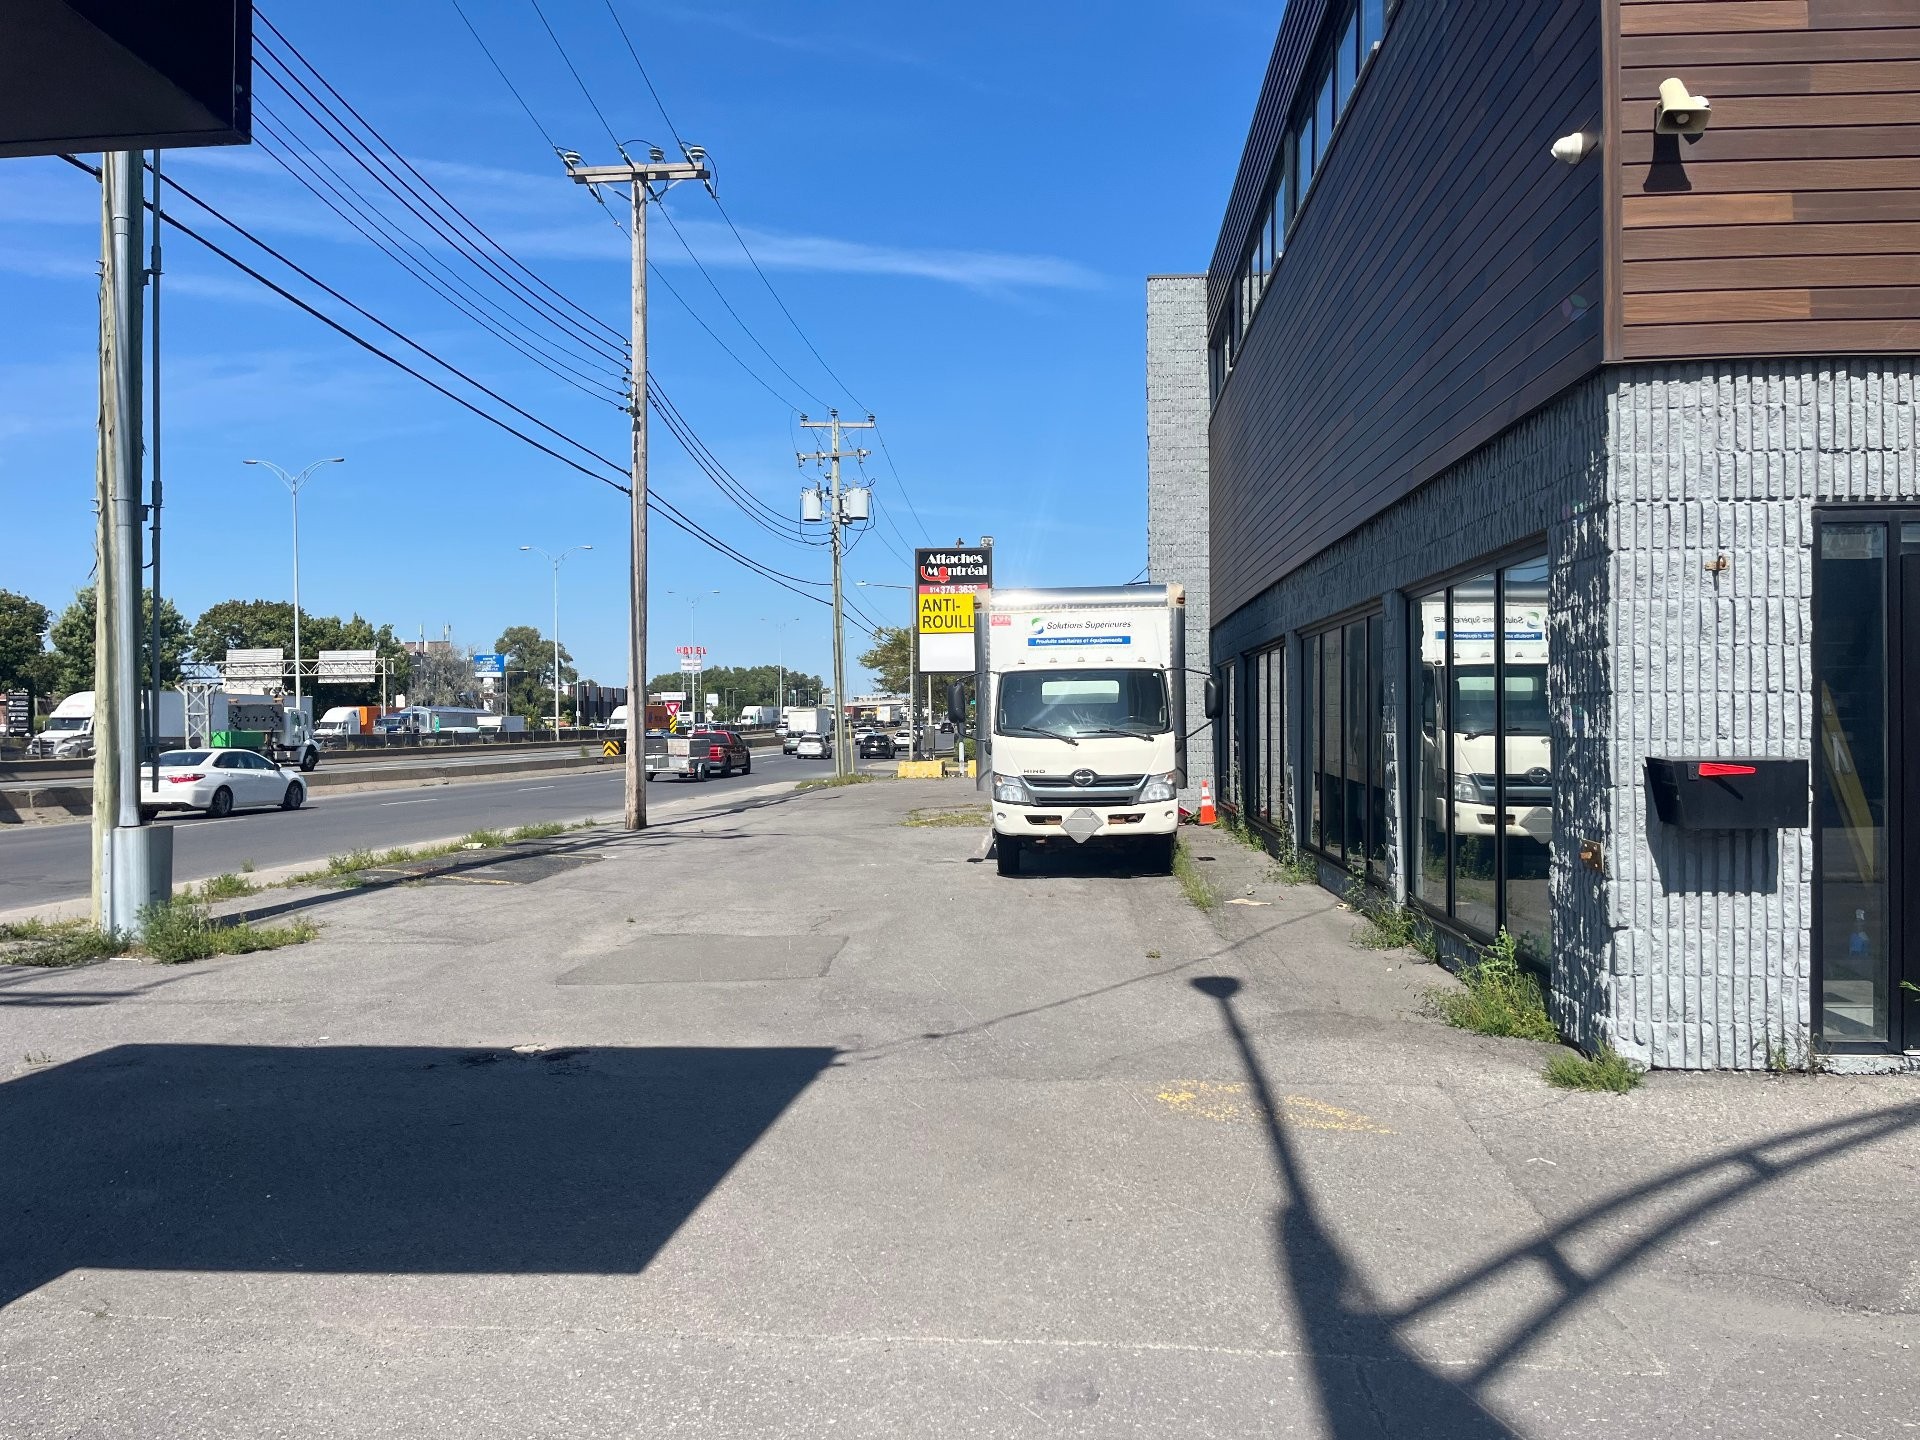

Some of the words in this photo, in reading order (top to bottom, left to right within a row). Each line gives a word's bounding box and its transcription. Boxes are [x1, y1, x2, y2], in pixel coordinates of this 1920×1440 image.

[926, 554, 983, 564] Attaches
[926, 565, 988, 576] Montréal
[922, 598, 960, 612] ANTI-
[922, 614, 974, 629] ROUILL
[1046, 621, 1083, 630] Solutions
